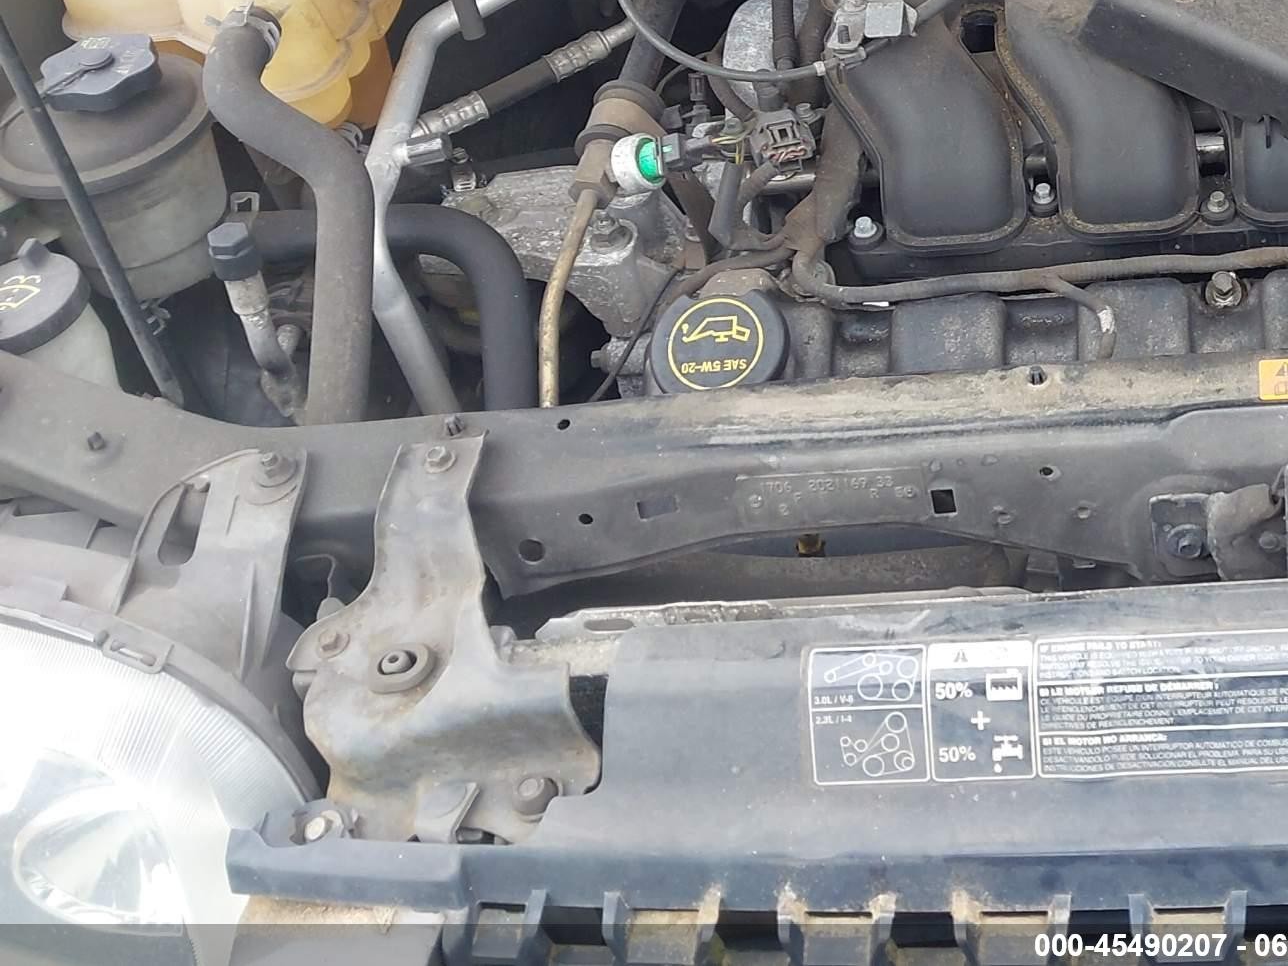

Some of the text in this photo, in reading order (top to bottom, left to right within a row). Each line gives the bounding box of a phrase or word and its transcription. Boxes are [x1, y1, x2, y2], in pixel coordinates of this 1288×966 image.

[681, 359, 747, 374] SAE 5W-20
[935, 682, 973, 700] 50%
[814, 695, 833, 705] 3.0L
[939, 745, 976, 763] 50%
